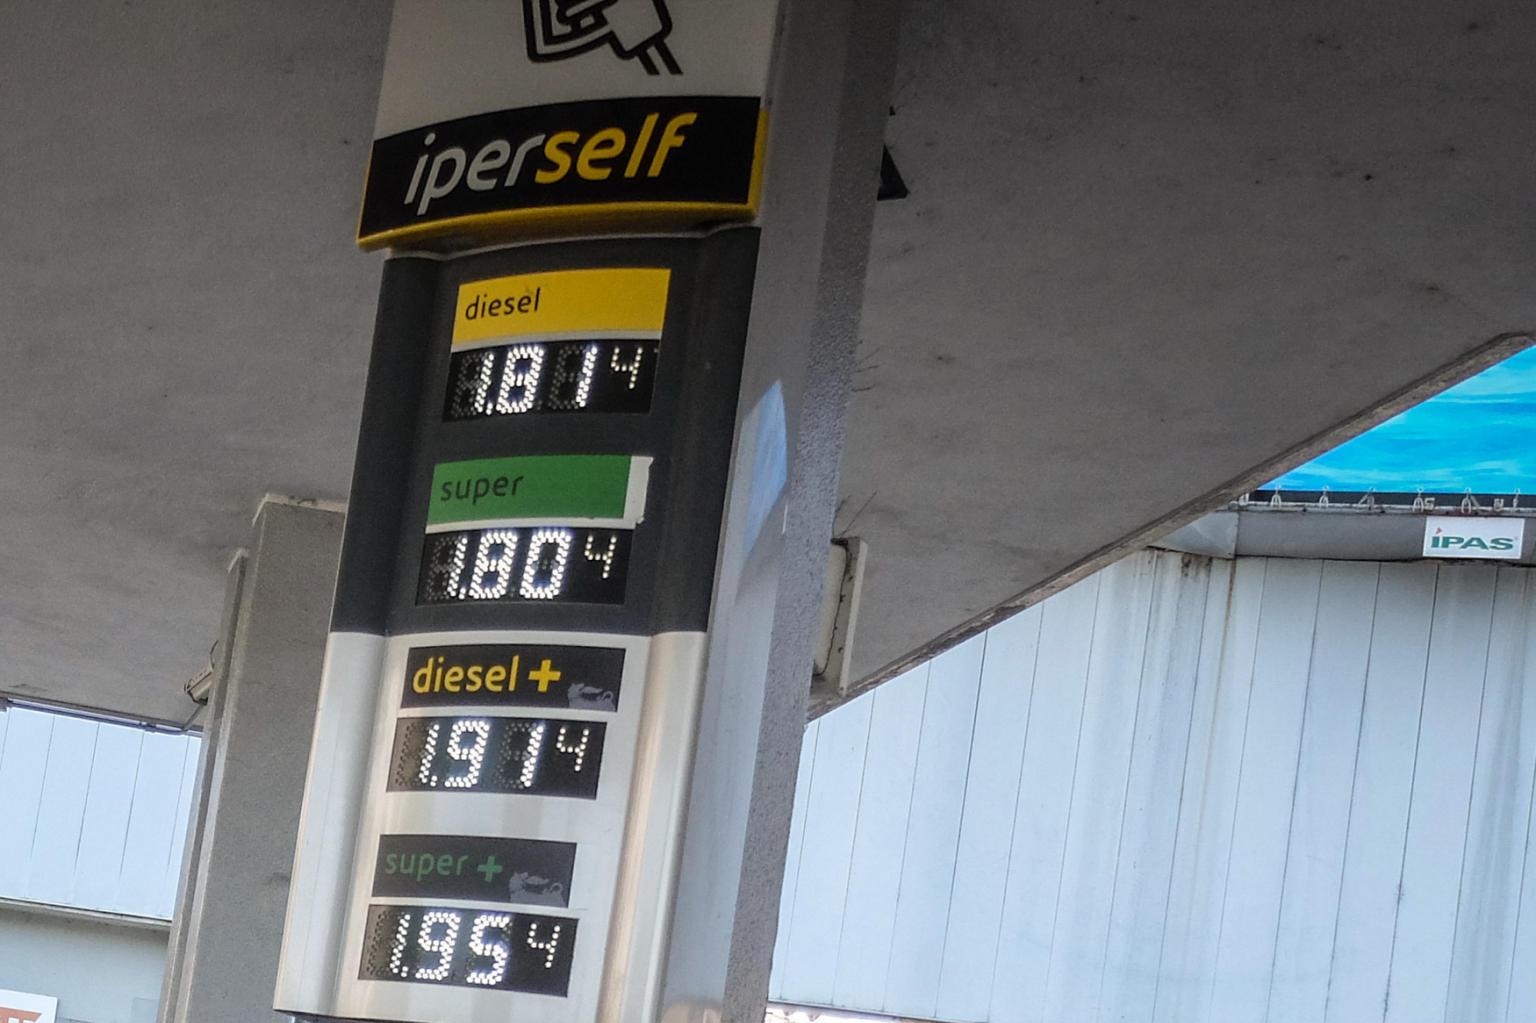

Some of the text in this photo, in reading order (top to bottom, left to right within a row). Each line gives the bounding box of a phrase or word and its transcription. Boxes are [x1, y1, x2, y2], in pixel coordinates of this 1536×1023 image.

[404, 112, 697, 216] iperself
[465, 287, 541, 320] diesel
[440, 475, 524, 505] super
[413, 655, 519, 693] diesel
[385, 853, 468, 881] super
